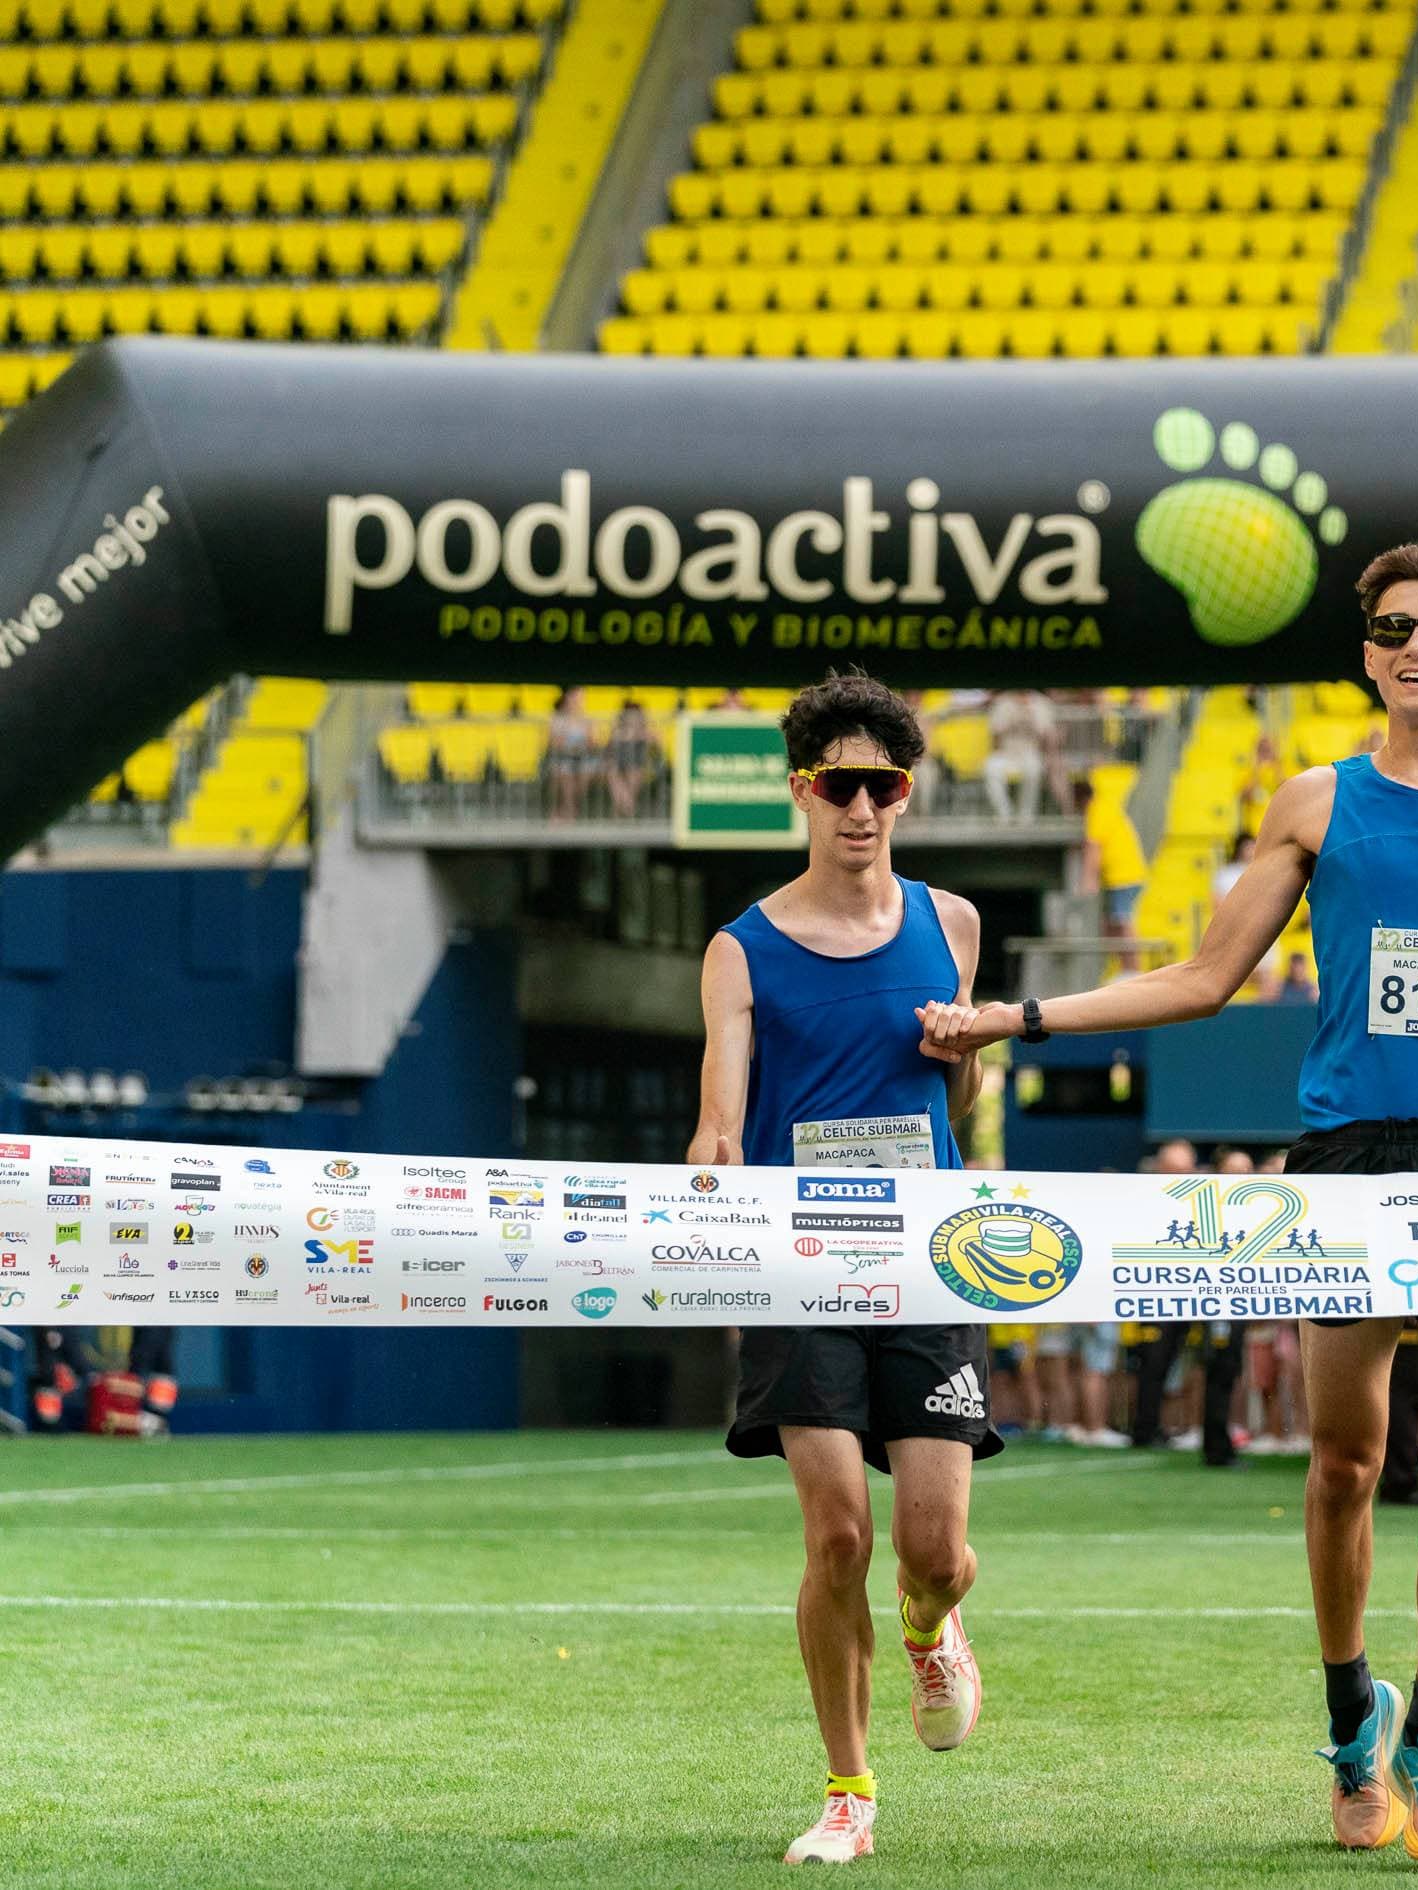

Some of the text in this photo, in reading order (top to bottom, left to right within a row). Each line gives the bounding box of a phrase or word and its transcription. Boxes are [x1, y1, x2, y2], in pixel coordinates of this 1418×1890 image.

[57, 485, 170, 604] mejor
[323, 467, 1108, 638] podoactiva
[440, 603, 1102, 649] PODOLOGÍA Y BIOMECÁNICA
[823, 1126, 865, 1139] CELTIC
[816, 1149, 876, 1161] MACAPACA
[403, 1165, 466, 1179] Isoltec
[312, 1181, 371, 1191] Ajuntament
[323, 1188, 367, 1197] Vila-real
[49, 1195, 78, 1204] CREA
[425, 1187, 466, 1200] SACMI
[649, 1194, 763, 1205] VILLARREAL C.F.
[678, 1210, 772, 1225] CaixaBank
[1162, 1179, 1308, 1263] 12
[116, 1228, 141, 1239] EVA
[418, 1229, 449, 1237] Quadis
[304, 1240, 374, 1264] SME
[652, 1245, 761, 1262] COVALCA
[55, 1265, 89, 1273] Lucciola
[307, 1266, 372, 1274] VILA-REAL
[1112, 1263, 1371, 1285] CURSA SOLIDÀRIA
[169, 1291, 181, 1299] EL
[1199, 1285, 1287, 1296] PER PARELLES
[112, 1292, 155, 1303] infisport
[410, 1296, 466, 1308] incerco
[484, 1295, 549, 1311] FULGOR
[671, 1289, 771, 1306] ruralnostra
[800, 1296, 890, 1313] vidres
[1115, 1291, 1373, 1319] CELTIC SUBMARÍ
